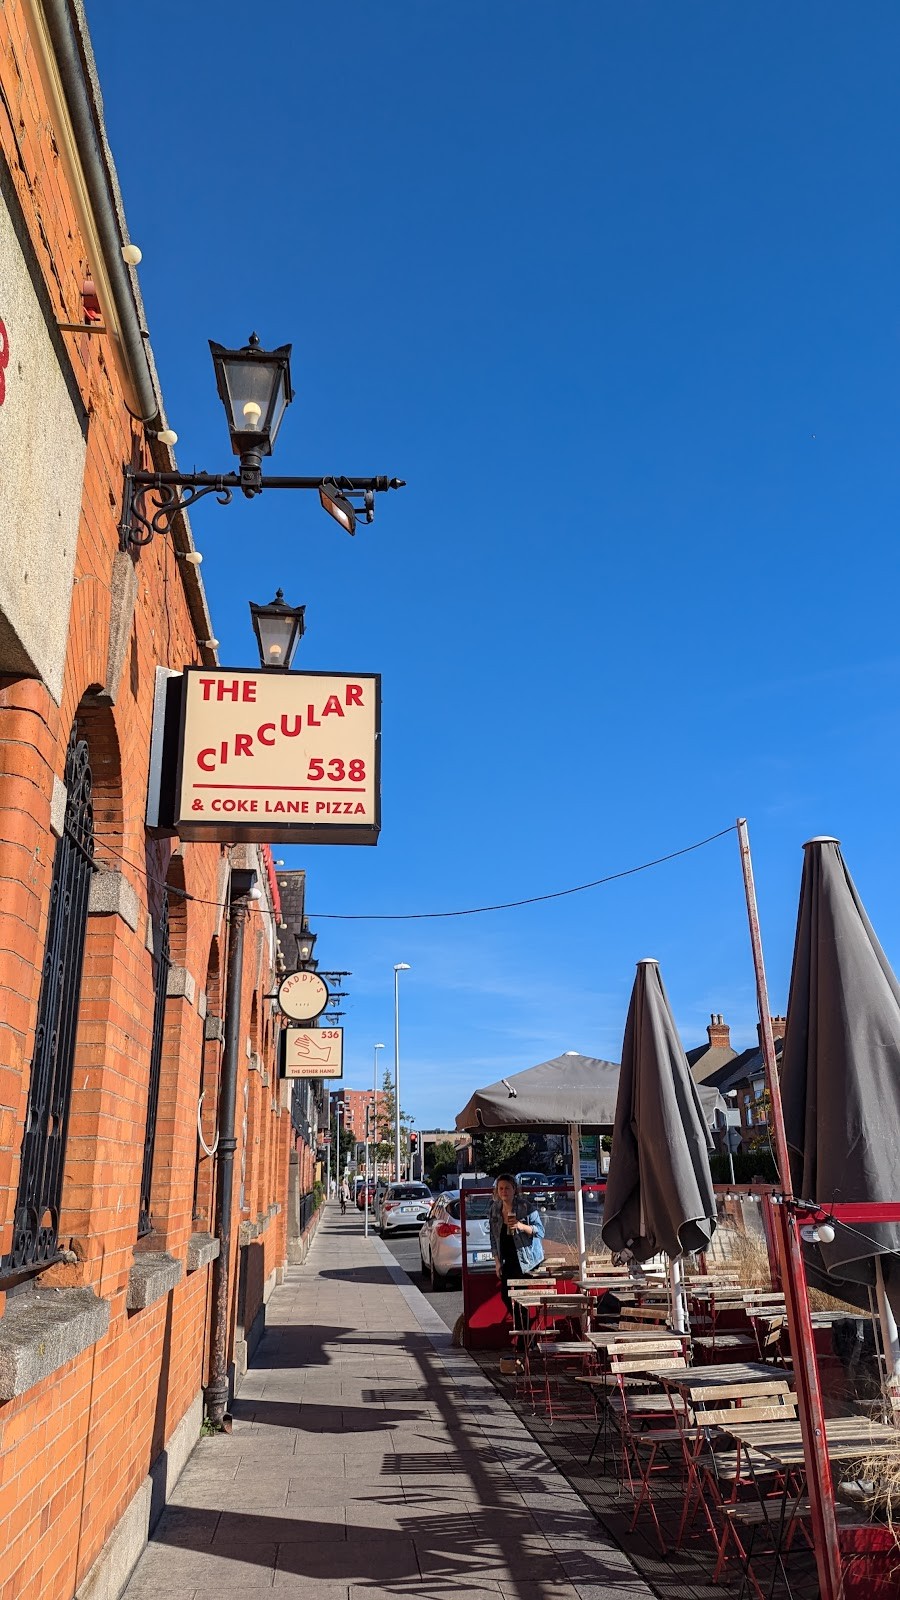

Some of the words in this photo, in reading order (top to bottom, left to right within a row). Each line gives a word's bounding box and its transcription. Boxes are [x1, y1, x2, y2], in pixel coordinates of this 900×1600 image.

[199, 678, 257, 703] THE
[196, 684, 365, 772] CIRCULAR
[306, 758, 366, 782] 538
[191, 798, 204, 812] &
[211, 799, 258, 813] COKE
[264, 800, 309, 814] LANE
[315, 801, 366, 815] PIZZA
[282, 974, 324, 993] DADDY'S
[321, 1031, 339, 1039] 536
